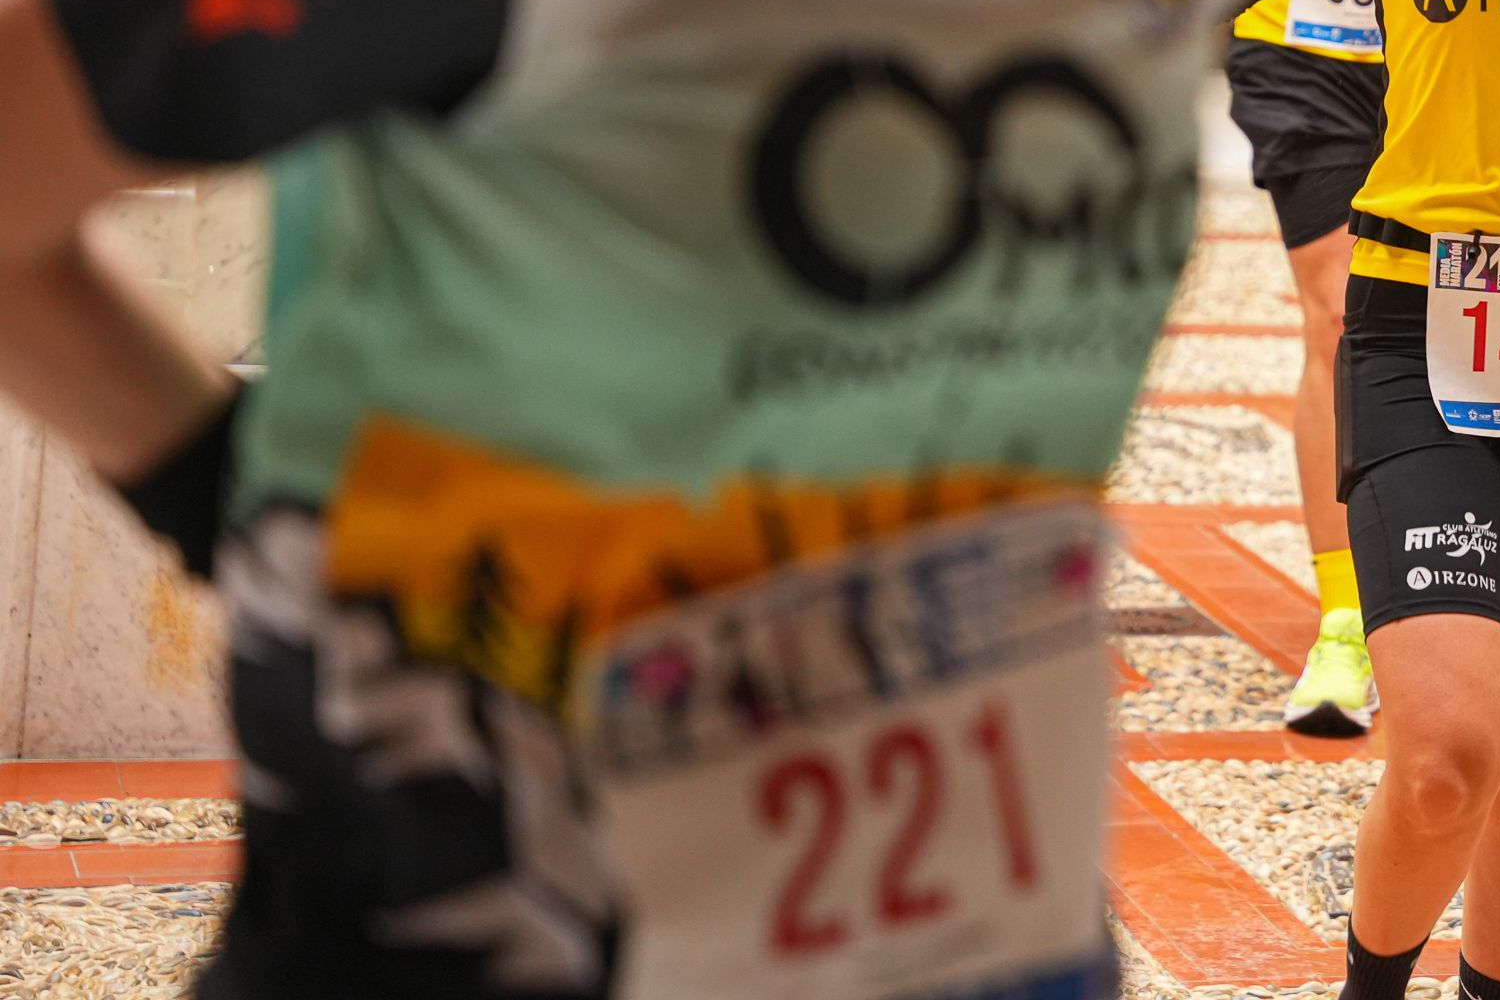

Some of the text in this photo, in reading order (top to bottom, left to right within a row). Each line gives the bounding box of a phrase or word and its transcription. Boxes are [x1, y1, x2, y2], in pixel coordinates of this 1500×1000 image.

[1439, 257, 1451, 287] MEDIA
[1442, 523, 1463, 532] CLUB
[1436, 533, 1497, 553] RAGALUZ
[1406, 566, 1497, 593] AIRZONE
[752, 694, 1044, 964] 221
